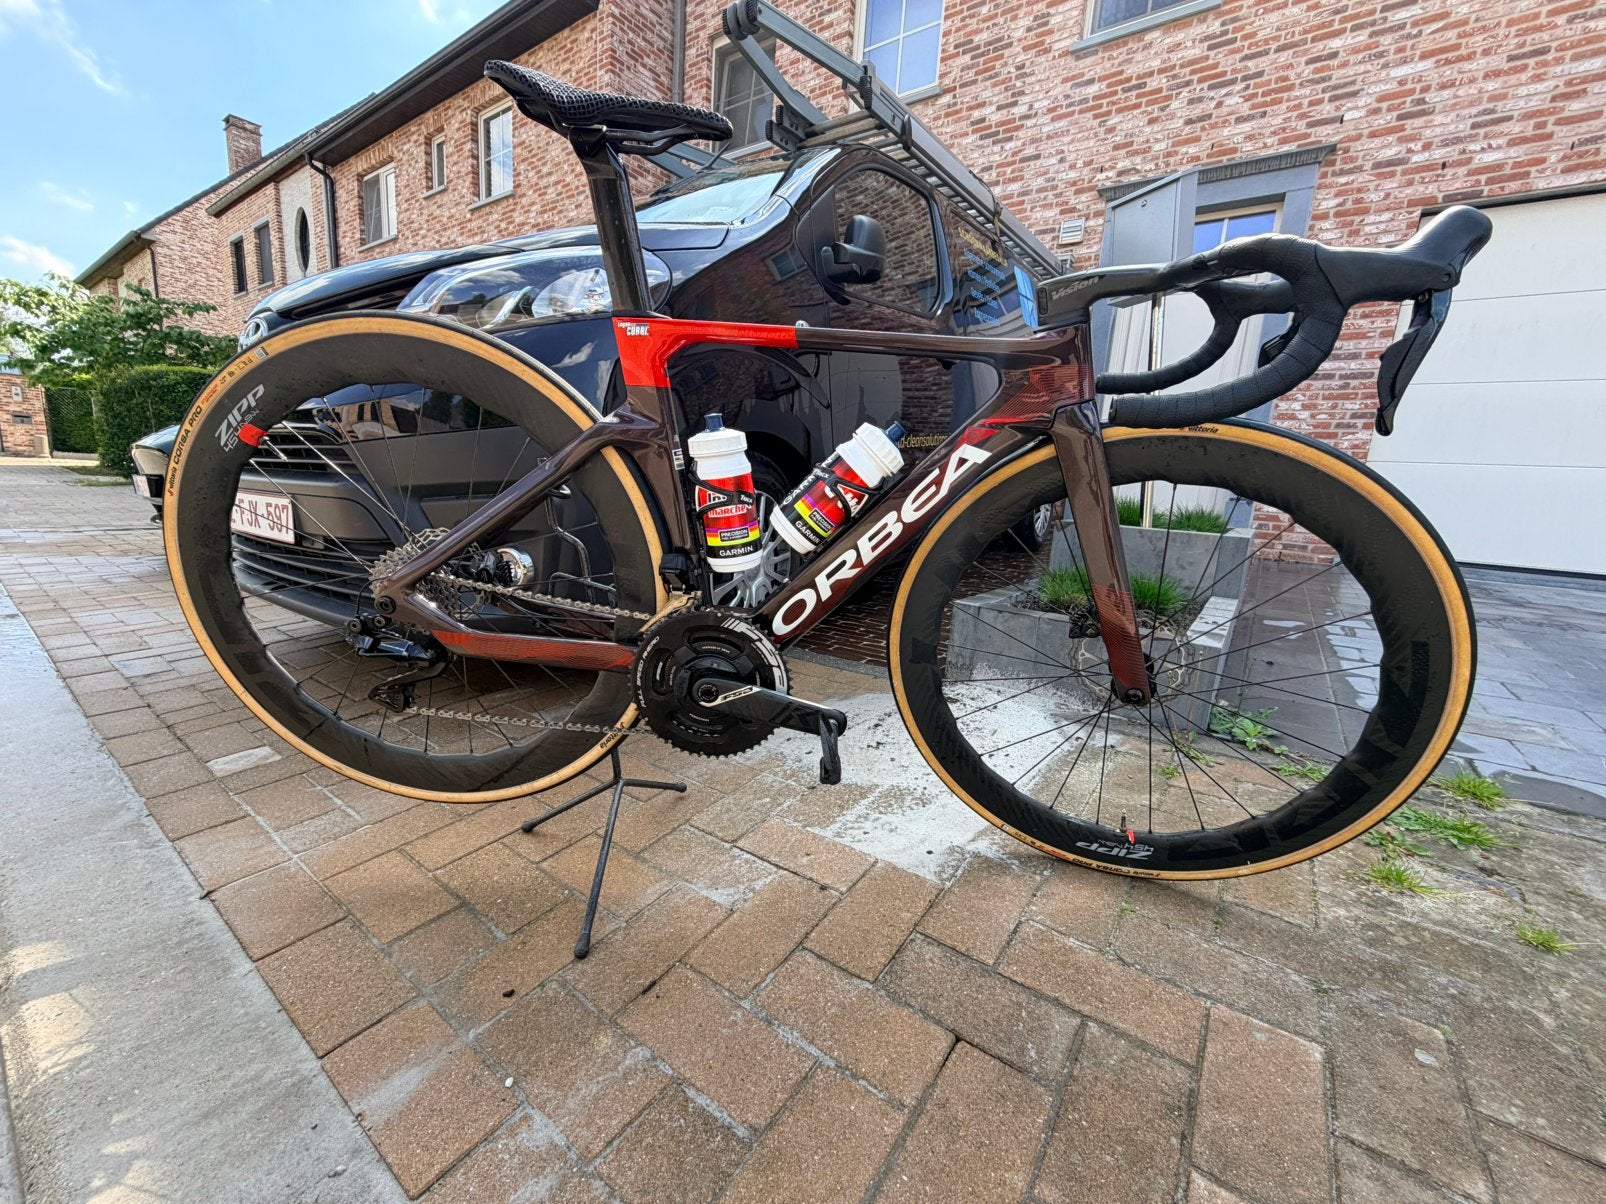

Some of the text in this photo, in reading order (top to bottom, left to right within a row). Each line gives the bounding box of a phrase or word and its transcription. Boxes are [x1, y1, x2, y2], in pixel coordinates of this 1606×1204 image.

[215, 383, 265, 447] ZIPP
[173, 428, 190, 465] CORSA
[188, 405, 203, 428] PRO
[1188, 425, 1219, 434] vittoria
[772, 443, 993, 637] ORBEA
[795, 520, 821, 544] GARMIN
[719, 545, 754, 557] GARMIN
[1075, 841, 1153, 861] ZIPP
